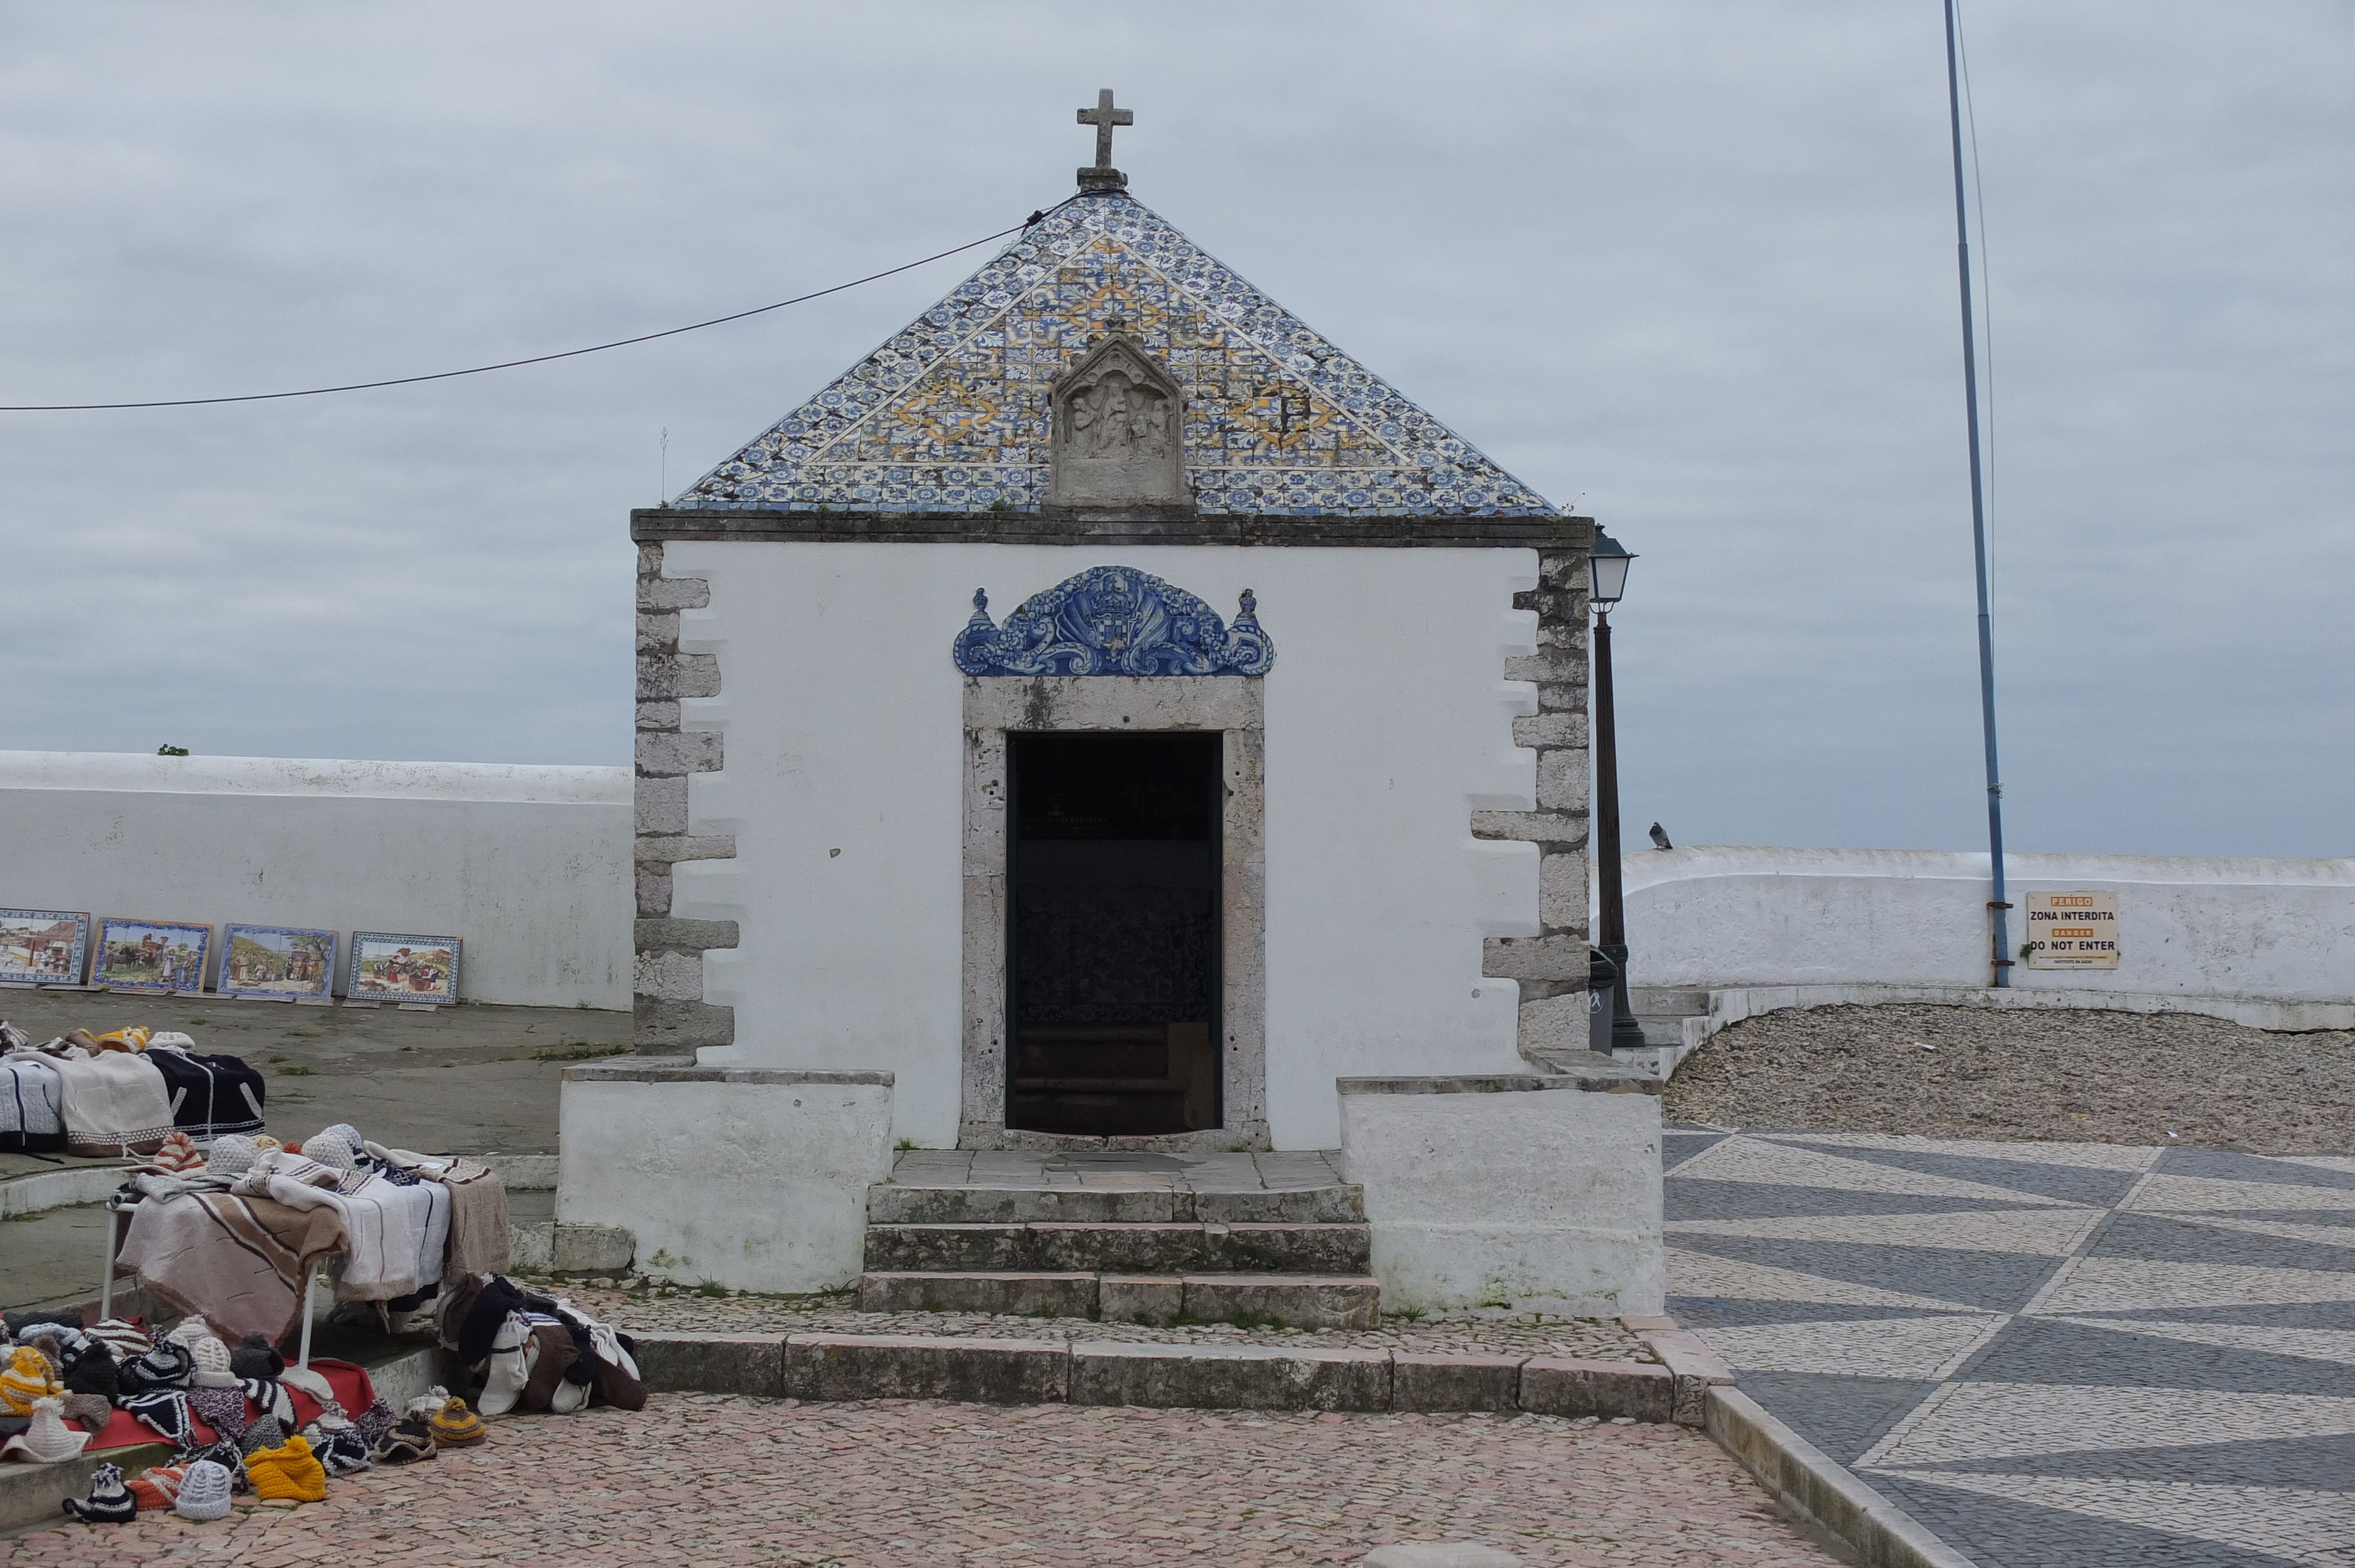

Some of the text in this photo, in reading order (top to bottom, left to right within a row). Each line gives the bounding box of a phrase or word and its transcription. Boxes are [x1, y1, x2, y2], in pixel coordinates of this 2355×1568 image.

[2030, 911, 2114, 921] ZONA INTERDITA
[2031, 941, 2115, 950] DO NOT ENTER
